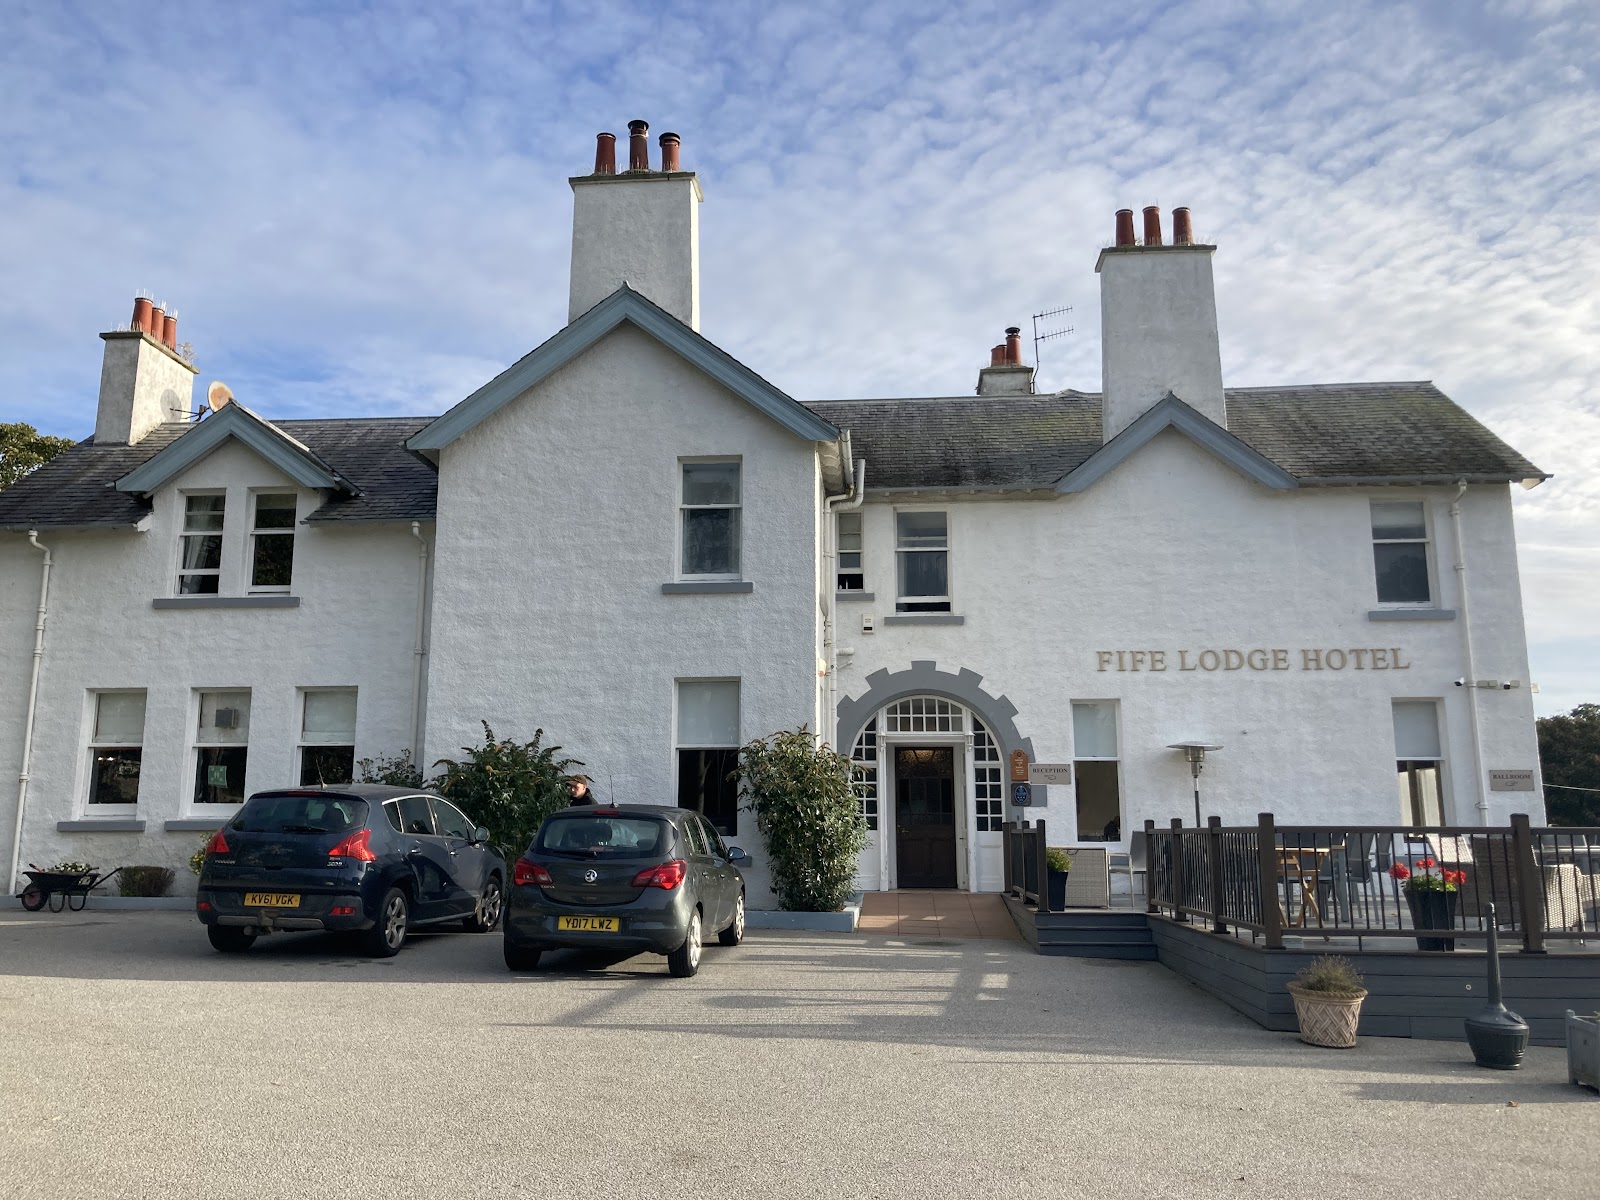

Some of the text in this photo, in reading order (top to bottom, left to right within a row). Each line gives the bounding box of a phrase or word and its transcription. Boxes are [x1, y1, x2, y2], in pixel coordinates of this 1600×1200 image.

[1096, 648, 1411, 672] FIFE LODGE HOTEL
[250, 894, 295, 905] KV61 VGK
[565, 918, 613, 930] YD17 LWZ
